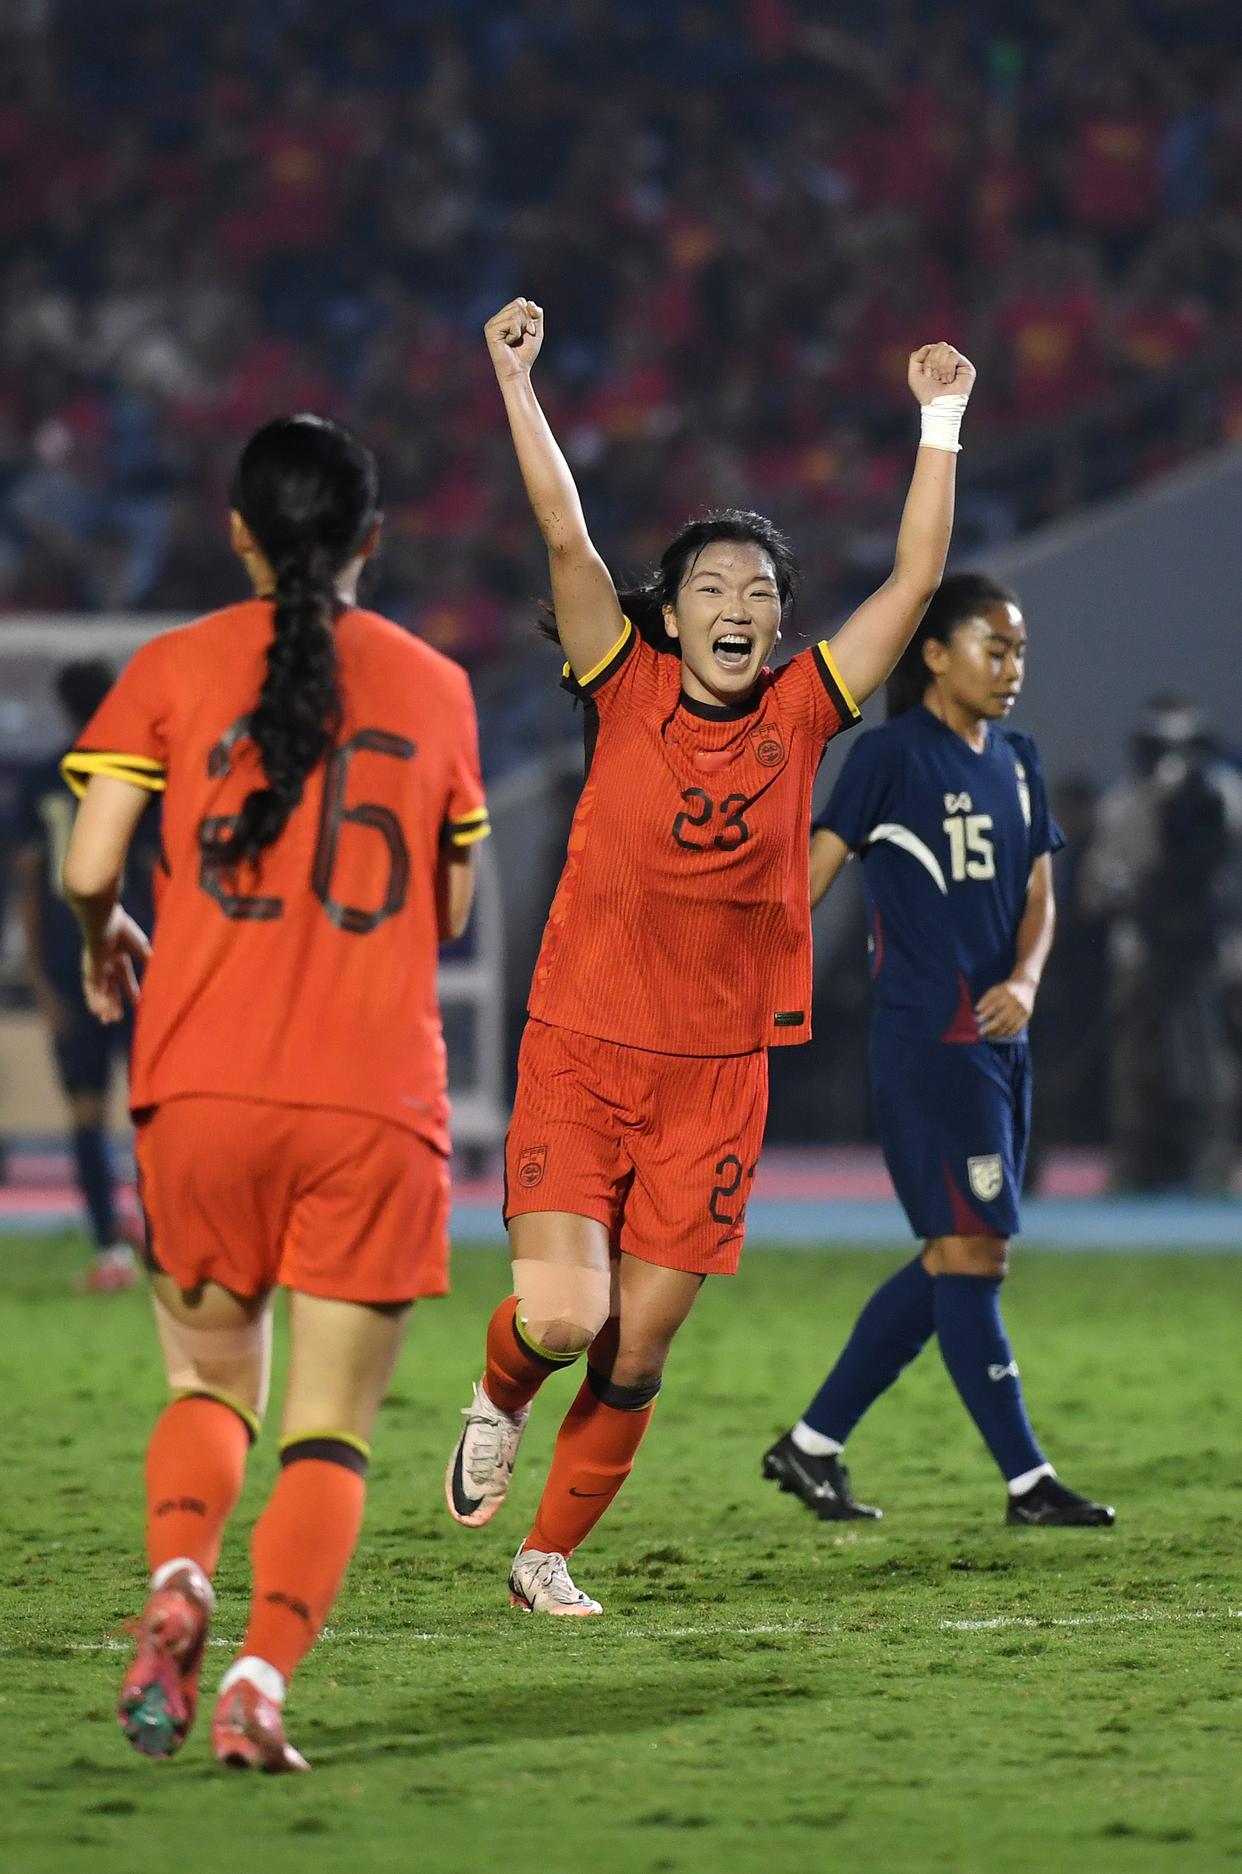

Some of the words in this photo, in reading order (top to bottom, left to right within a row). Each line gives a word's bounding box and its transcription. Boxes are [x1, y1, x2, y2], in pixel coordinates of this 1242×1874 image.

[671, 786, 750, 852] 23
[943, 814, 996, 882] 15
[709, 1153, 758, 1226] 2
